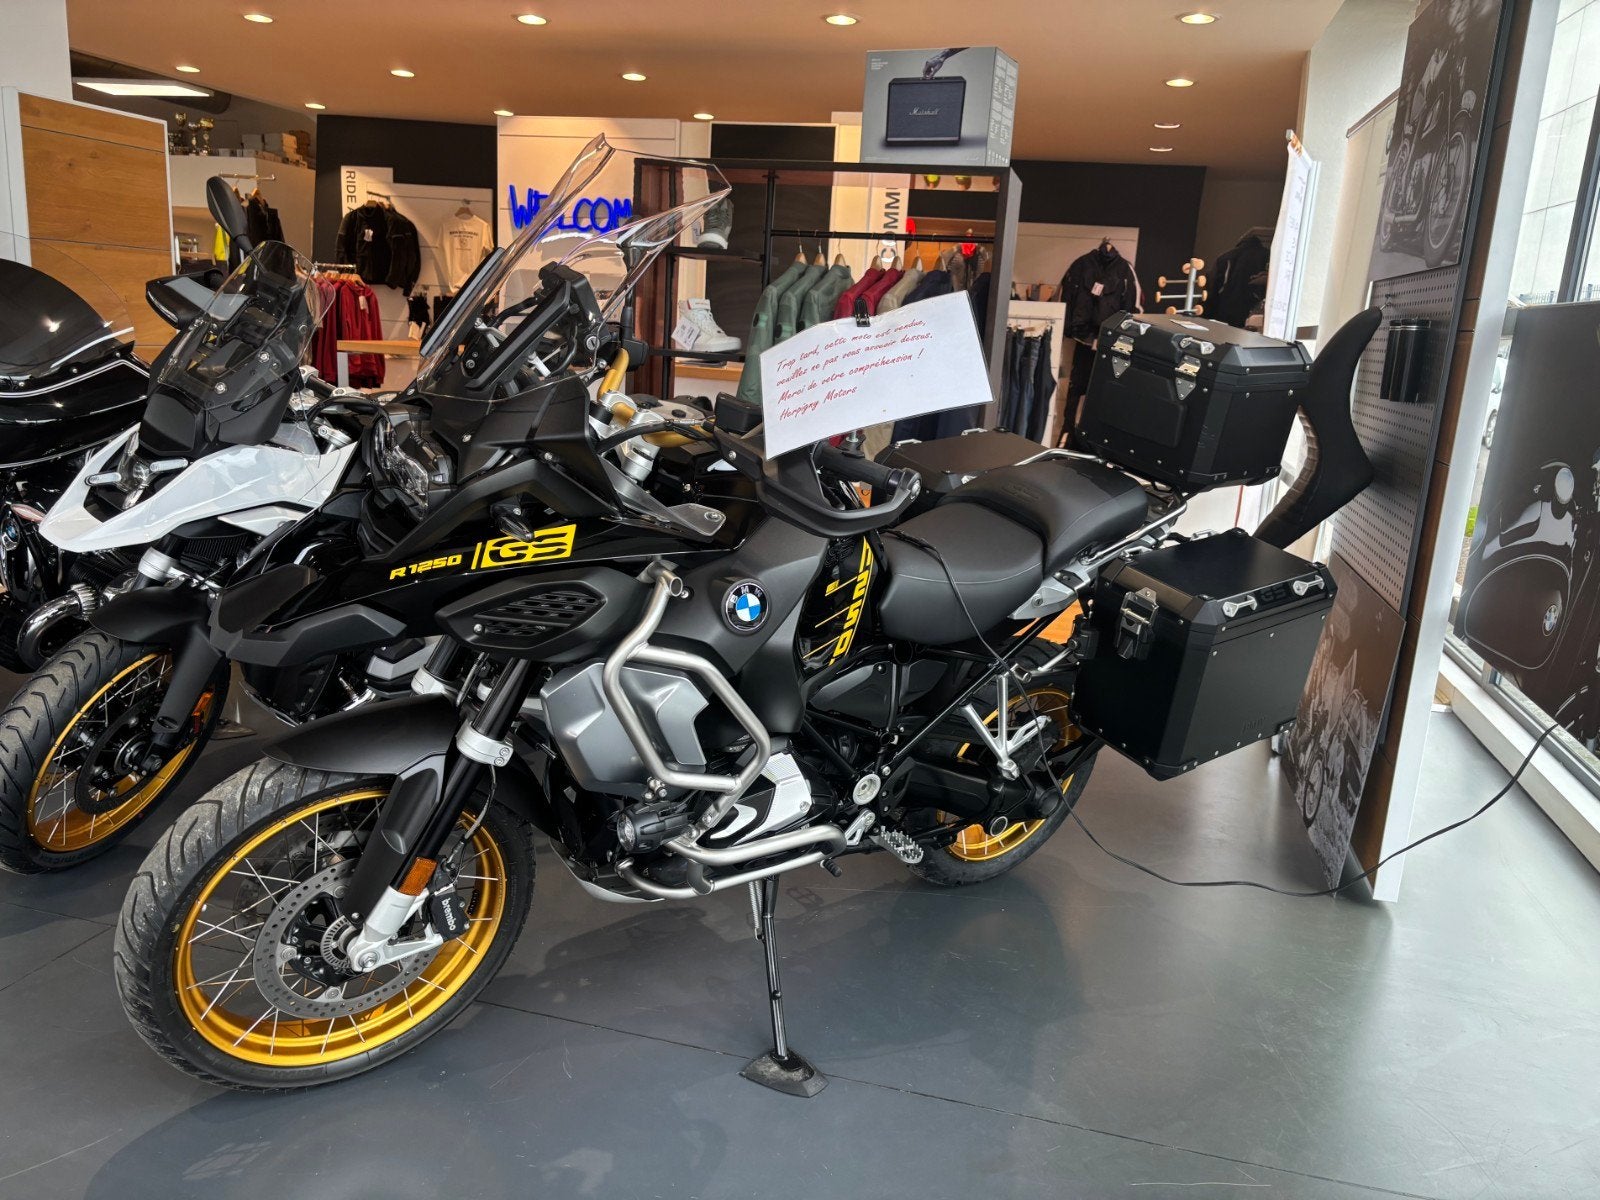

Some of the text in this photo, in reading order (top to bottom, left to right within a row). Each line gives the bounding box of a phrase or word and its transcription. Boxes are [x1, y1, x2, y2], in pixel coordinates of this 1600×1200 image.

[909, 107, 940, 116] Marshall
[345, 170, 357, 204] RIDE
[777, 358, 796, 372] Trop
[800, 345, 819, 360] tard,
[823, 356, 839, 370] pas
[778, 385, 806, 404] Merci
[808, 380, 818, 390] de
[823, 386, 858, 404] Motors
[389, 529, 570, 580] R 1250 GS
[442, 898, 456, 931] brembo
